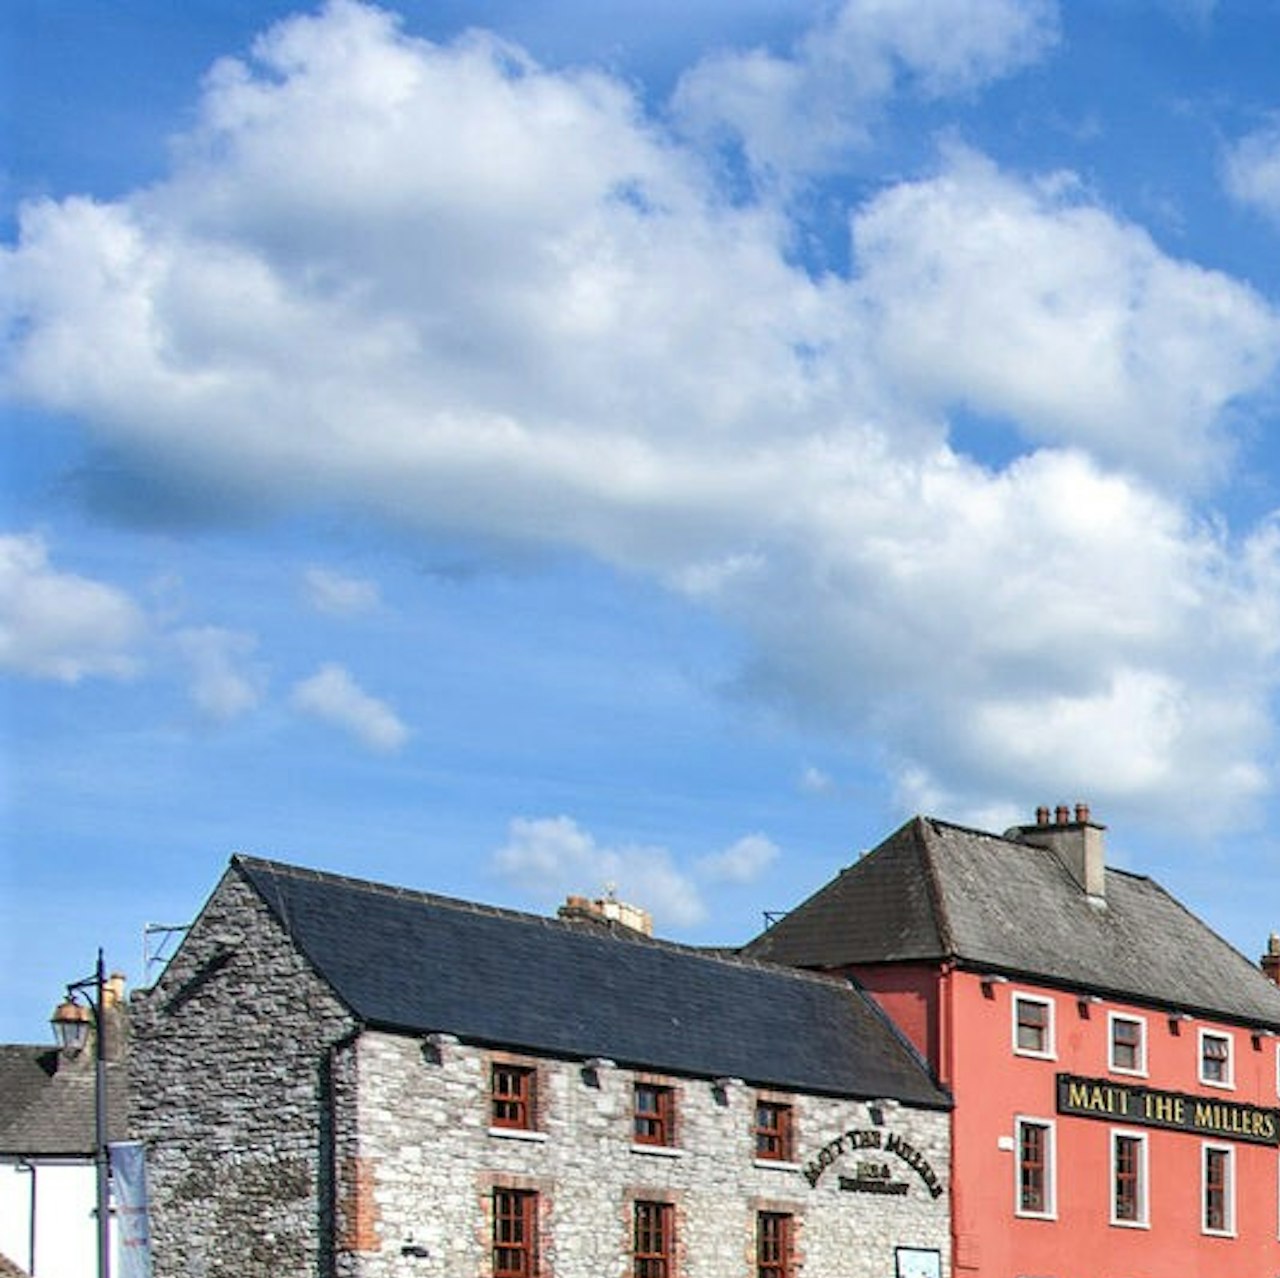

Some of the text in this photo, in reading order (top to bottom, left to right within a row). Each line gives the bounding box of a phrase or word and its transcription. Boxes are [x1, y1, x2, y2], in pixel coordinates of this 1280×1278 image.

[1069, 1083, 1275, 1138] MATT THE MILLERS
